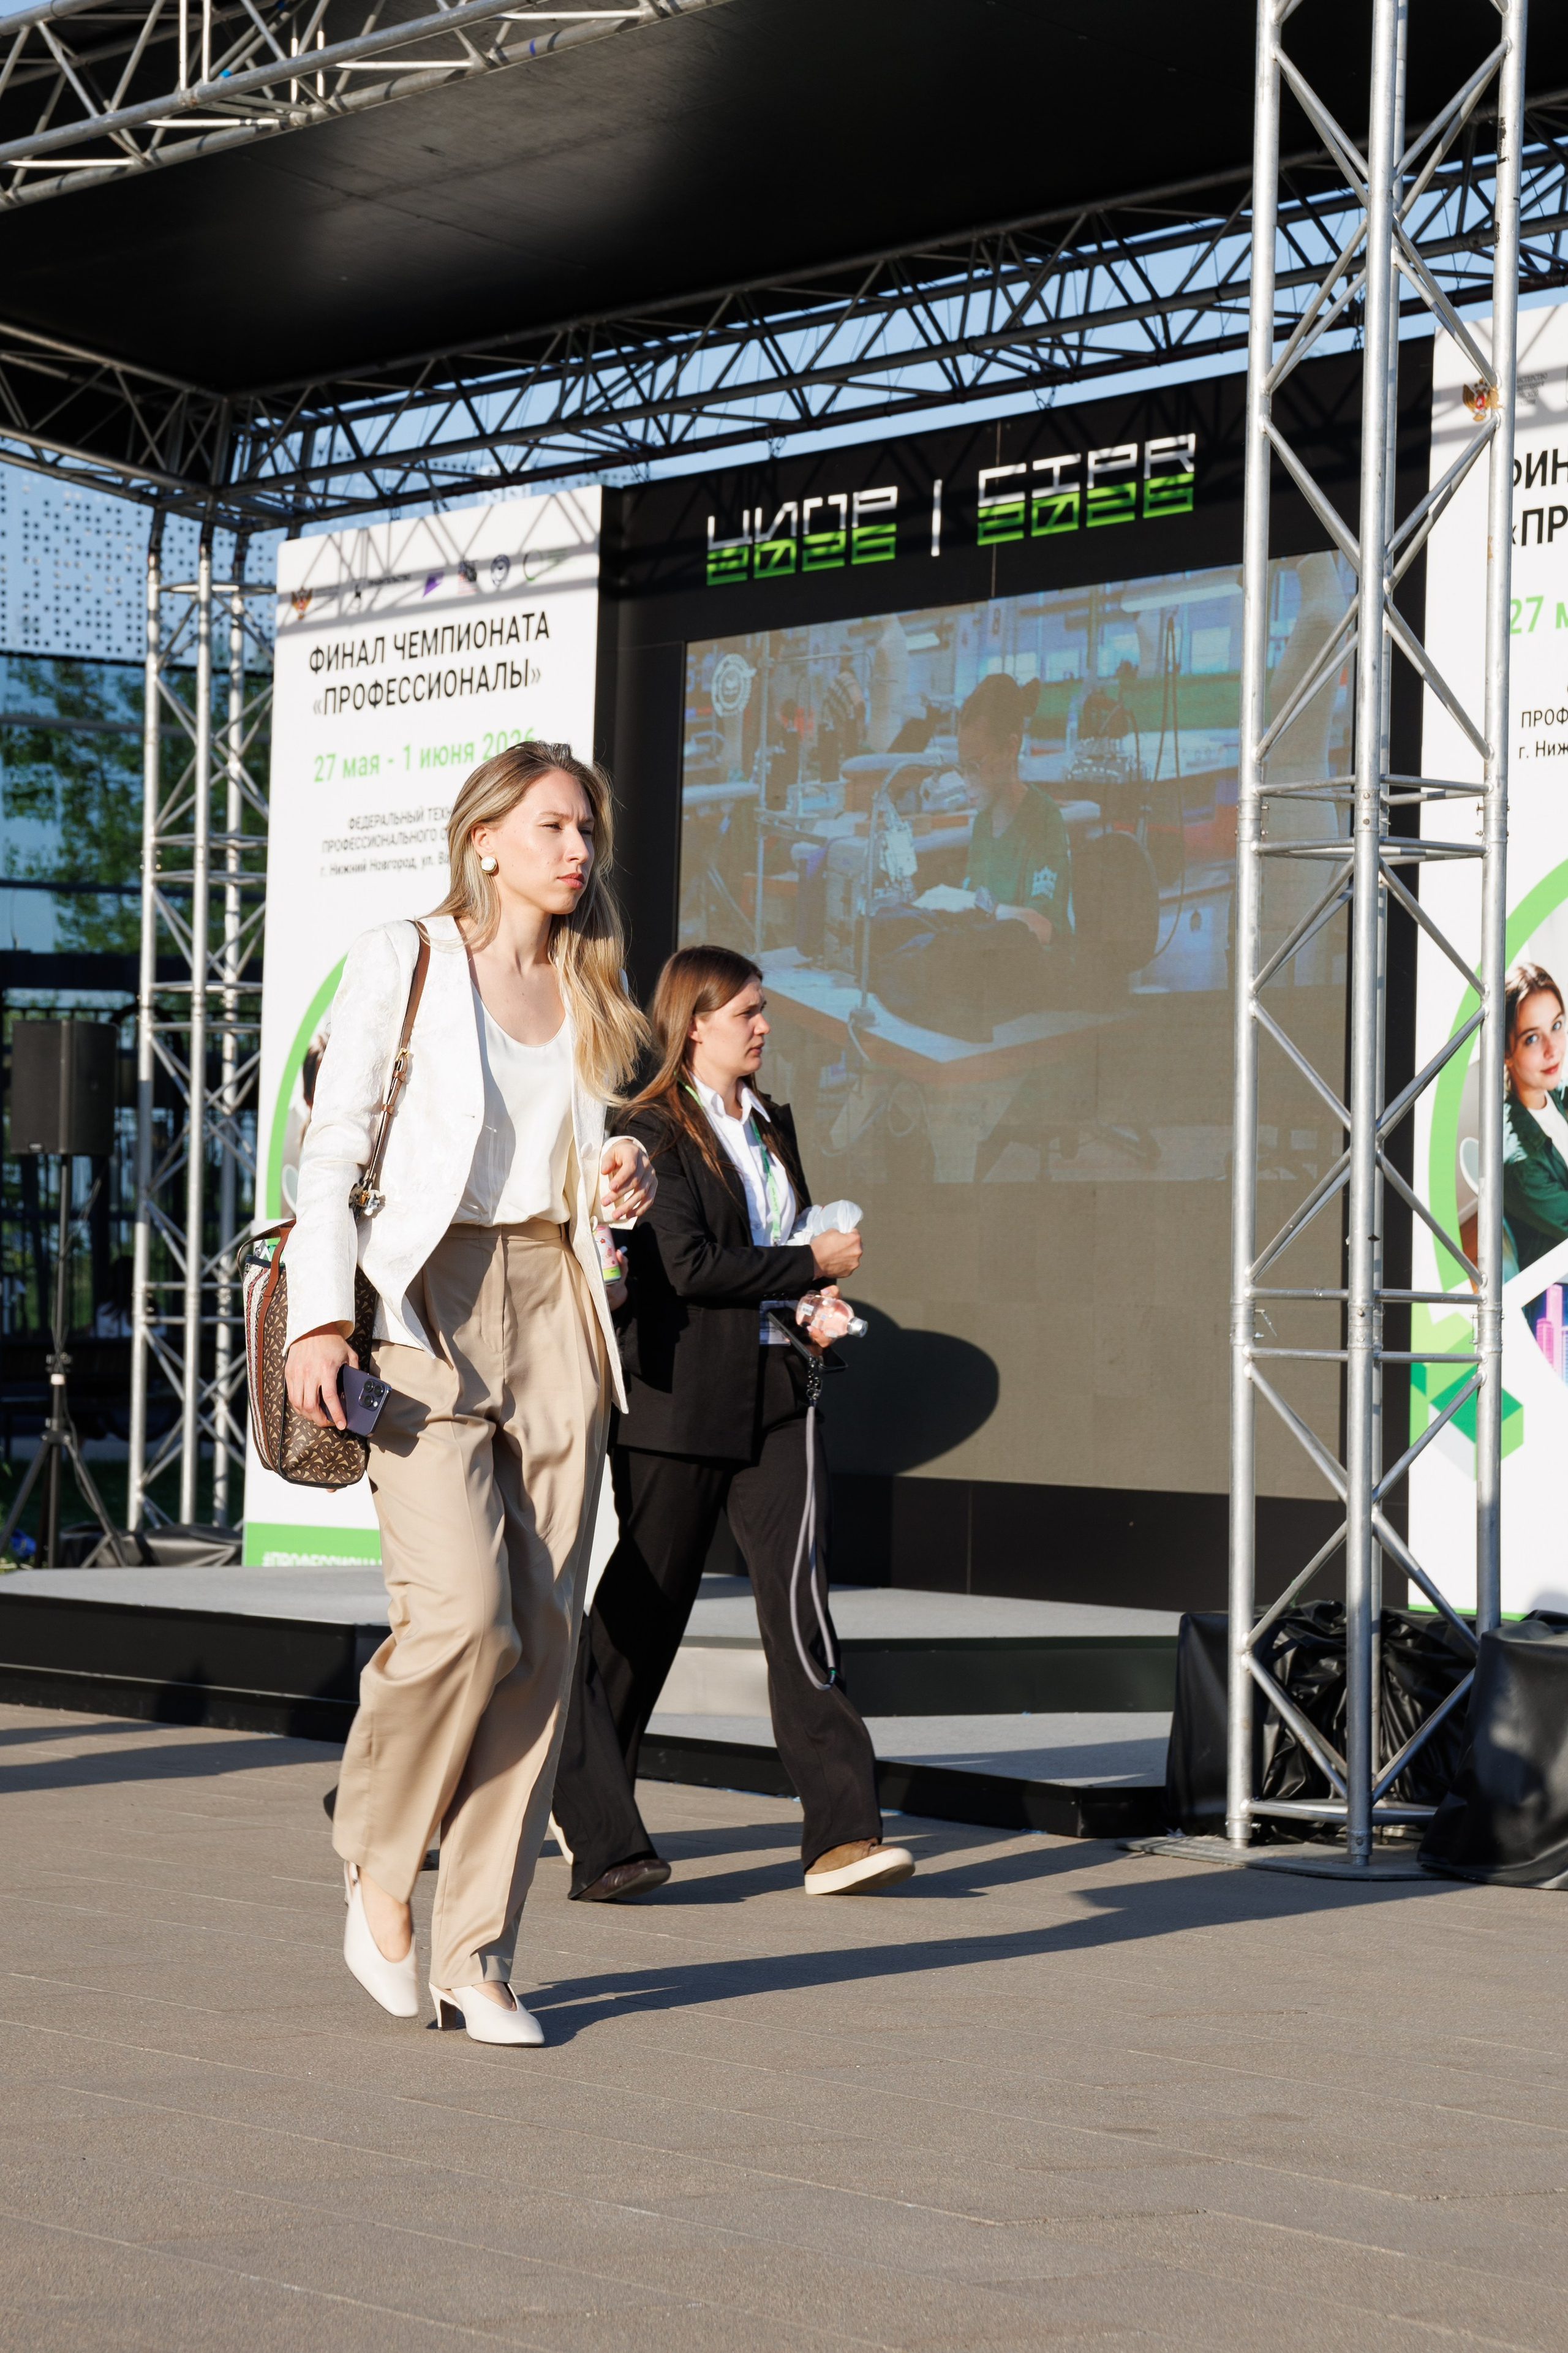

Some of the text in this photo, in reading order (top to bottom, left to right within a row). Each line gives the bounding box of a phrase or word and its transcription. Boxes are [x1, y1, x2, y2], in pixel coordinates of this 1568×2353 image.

[978, 433, 1196, 507] CIPR
[707, 486, 898, 550] ЦИПР
[977, 472, 1194, 546] 2026
[706, 523, 897, 586] 2026
[1509, 595, 1544, 635] 27
[309, 611, 550, 674] ФИНАЛ ЧЕМПИОНАТА
[312, 658, 541, 716] «ПРОФЕССИОНАЛЫ»
[1521, 707, 1568, 728] ПРОФ
[314, 753, 336, 783] 27
[343, 754, 380, 779] мая
[403, 744, 411, 771] 1
[420, 742, 475, 769] июня
[1519, 746, 1529, 759] г.
[348, 806, 424, 830] ФЕДЕРАЛЬНЫЙ
[322, 828, 437, 853] ПРОФЕССИОНАЛЬНОГО
[330, 857, 366, 876] Нижний
